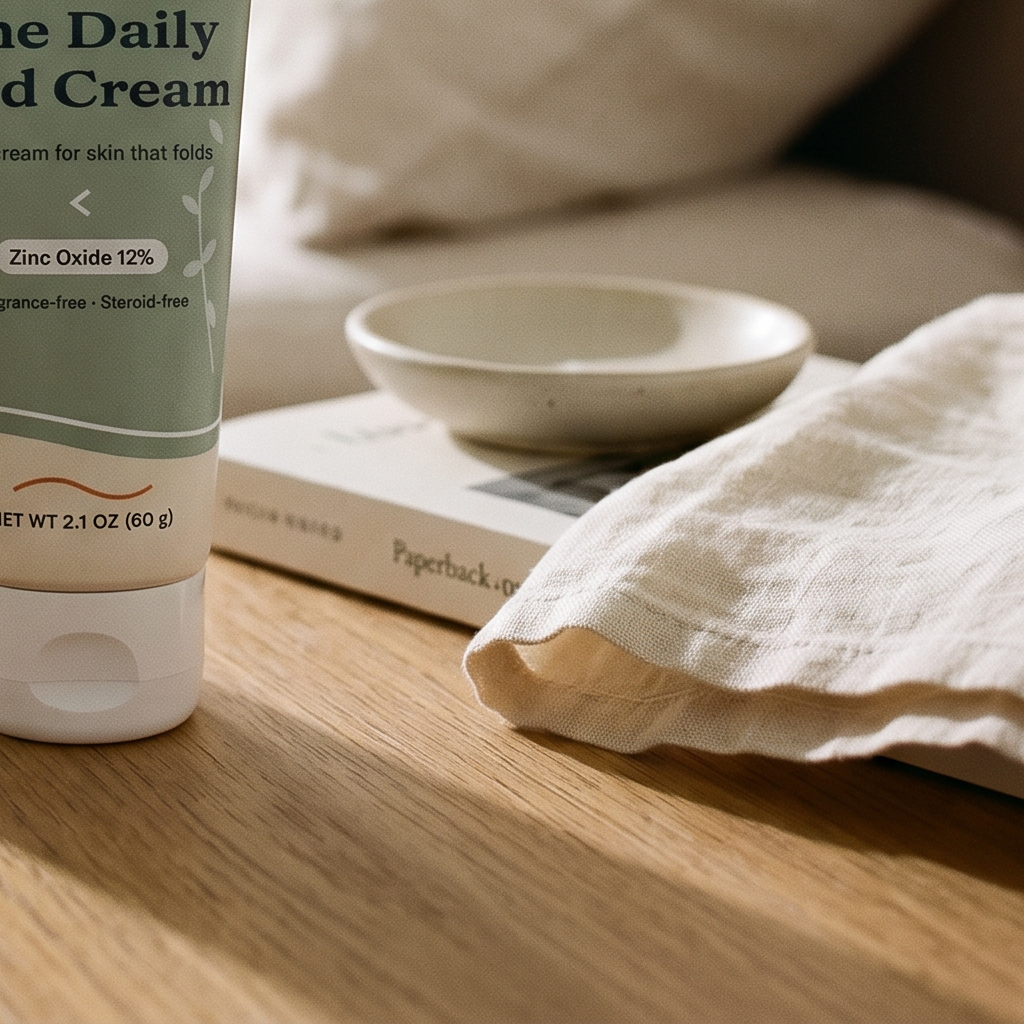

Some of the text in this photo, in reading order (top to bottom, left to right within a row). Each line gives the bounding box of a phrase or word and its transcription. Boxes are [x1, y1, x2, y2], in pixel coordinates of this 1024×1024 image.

[67, 9, 219, 61] Daily
[53, 69, 230, 109] Cream
[54, 143, 81, 162] for
[86, 143, 125, 162] skin
[130, 143, 168, 162] that
[172, 143, 214, 162] folds
[9, 248, 155, 266] Zinc Oxide 12%
[100, 293, 189, 310] Steroid-free
[28, 513, 58, 529] WT
[62, 514, 87, 530] 2.1
[92, 513, 119, 530] OZ
[124, 511, 155, 532] (60
[158, 507, 174, 530] g)
[391, 537, 491, 590] Paperback
